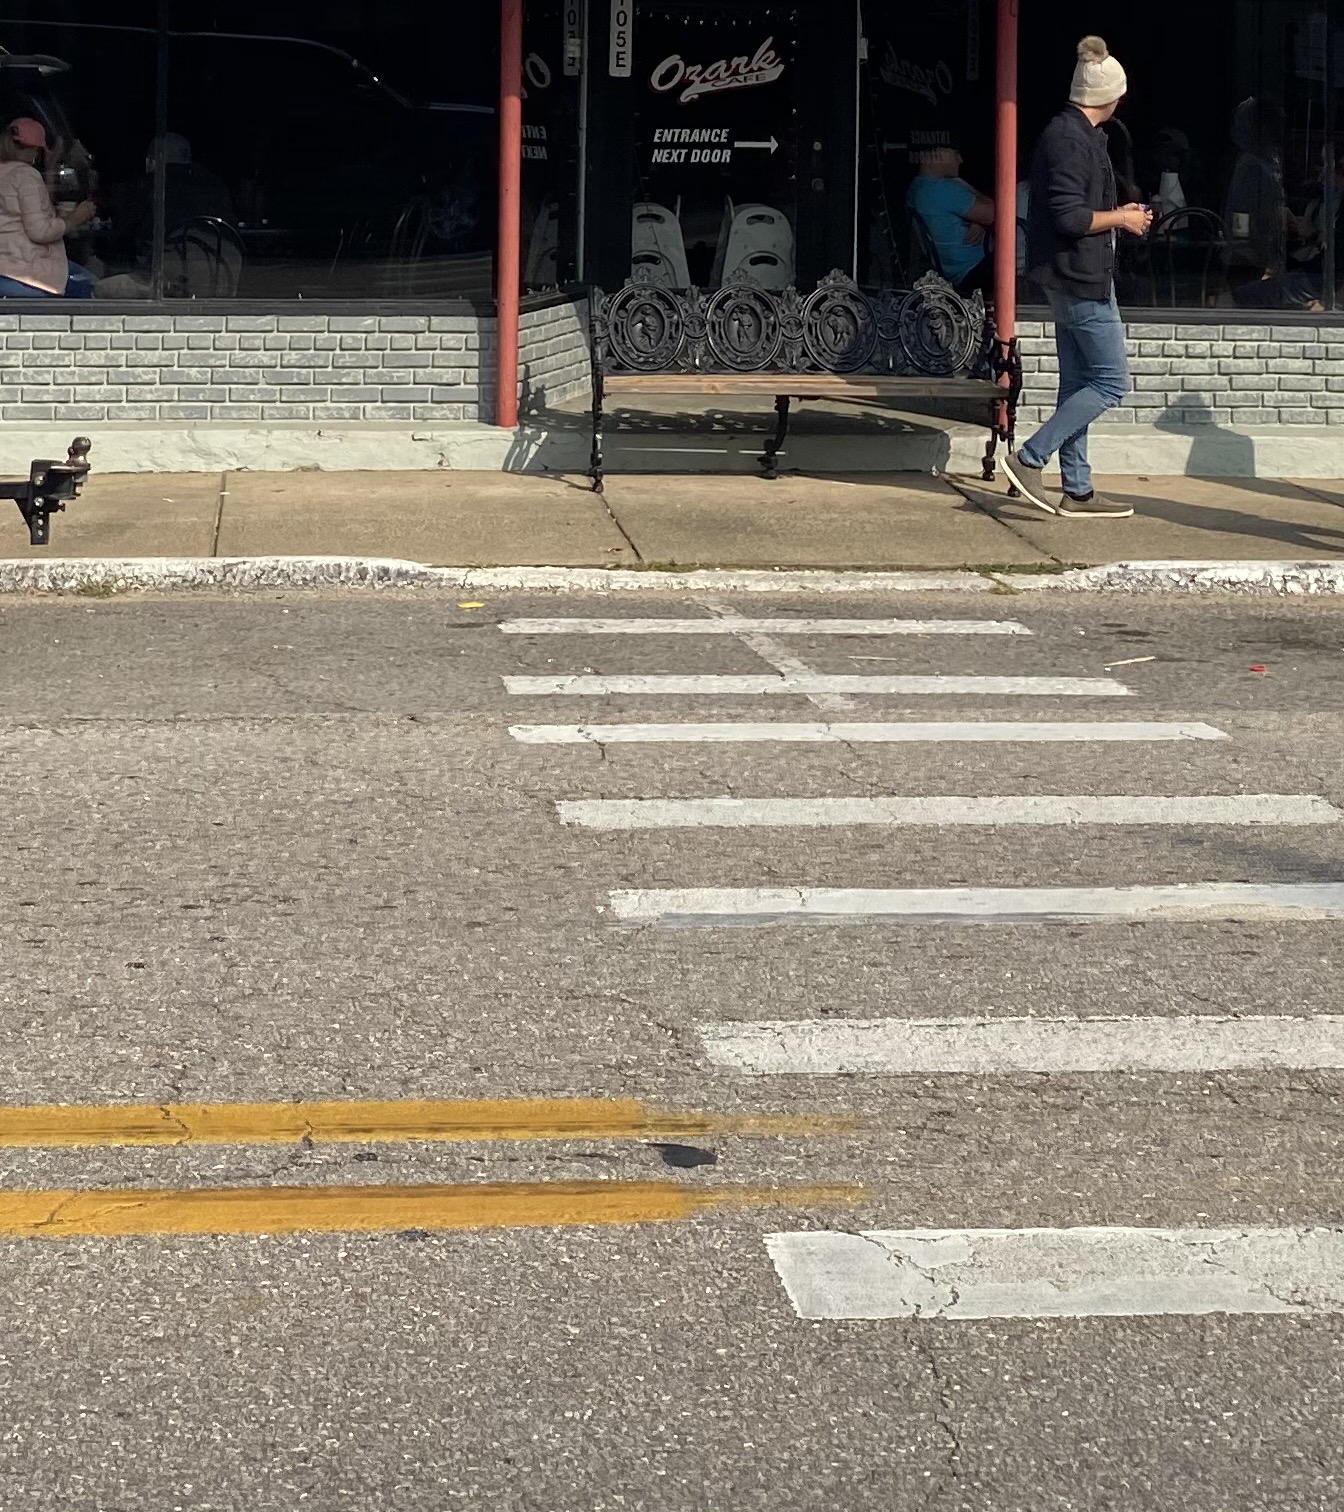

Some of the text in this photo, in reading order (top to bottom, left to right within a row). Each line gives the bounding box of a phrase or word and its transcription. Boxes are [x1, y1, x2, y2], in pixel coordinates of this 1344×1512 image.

[649, 35, 785, 103] Ozark
[653, 128, 730, 143] ENTRANCE
[651, 149, 732, 163] NEXT DOOR
